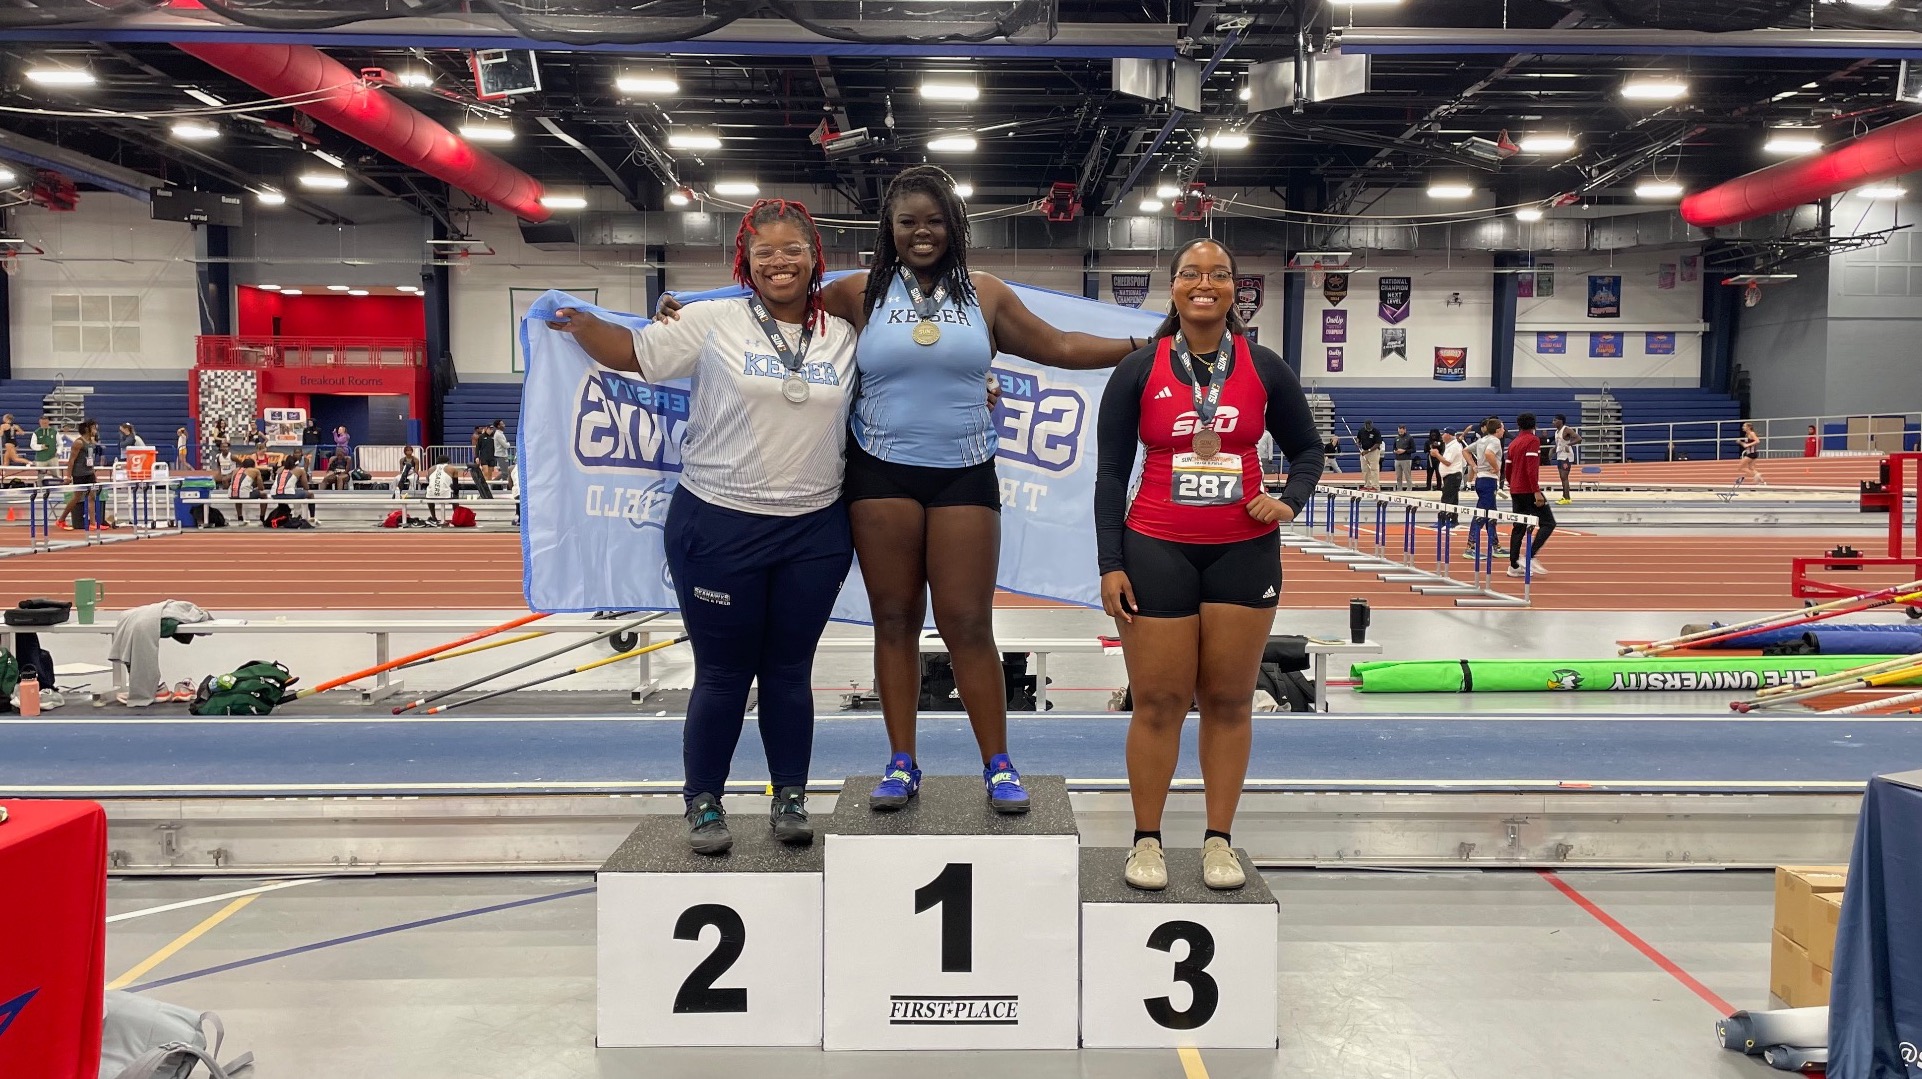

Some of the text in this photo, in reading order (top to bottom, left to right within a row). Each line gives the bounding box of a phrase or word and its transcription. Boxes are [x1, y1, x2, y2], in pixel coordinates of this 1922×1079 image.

[1113, 276, 1148, 287] CHEERSPORT
[911, 288, 921, 301] SUN
[753, 304, 767, 320] SUN
[1326, 316, 1344, 325] OneUp
[770, 333, 784, 349] SUN
[300, 375, 384, 386] Breakout Rooms
[1208, 388, 1220, 405] SUN
[1178, 473, 1237, 498] 287
[1608, 671, 1759, 691] UNIVERSITY
[991, 772, 1012, 785] NIKE
[914, 862, 973, 973] 1
[672, 903, 748, 1014] 2
[1143, 920, 1219, 1030] 3
[889, 1001, 1018, 1018] FIRST PLACE
